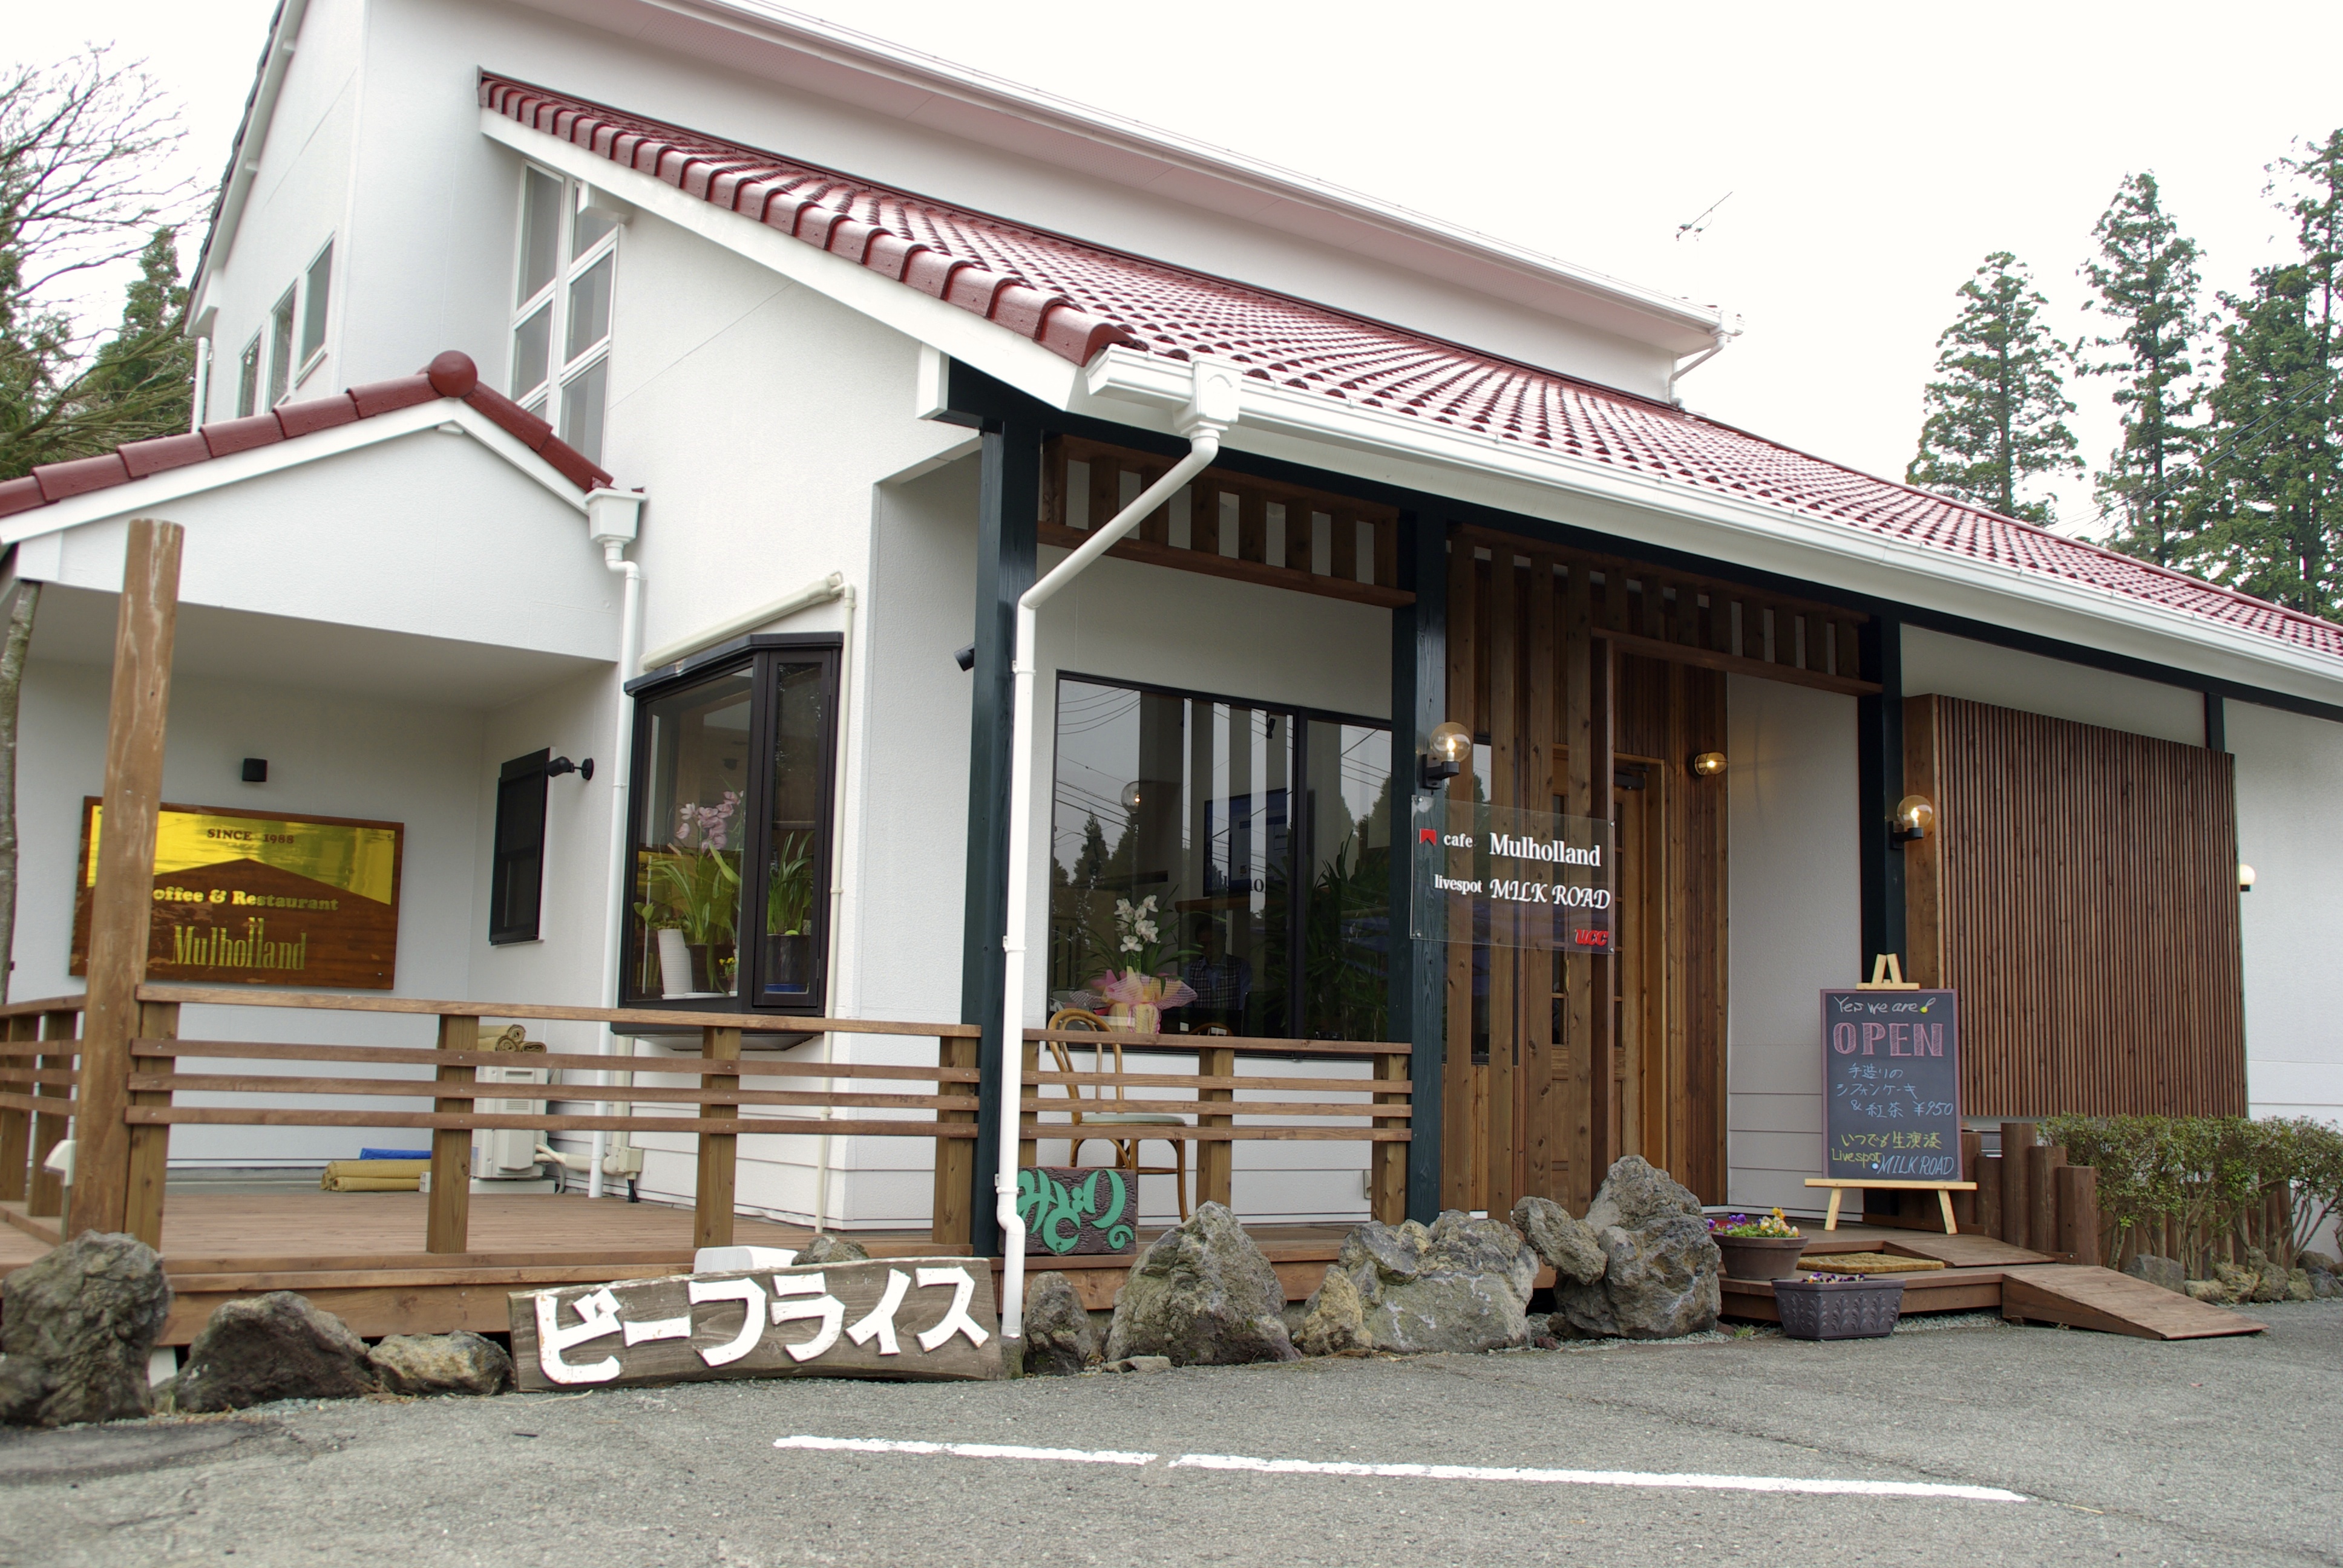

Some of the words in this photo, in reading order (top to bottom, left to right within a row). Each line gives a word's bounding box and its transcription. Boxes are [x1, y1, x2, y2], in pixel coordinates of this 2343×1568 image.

[207, 828, 252, 841] SINCE
[263, 834, 294, 844] 1988
[1443, 833, 1473, 848] cafe
[1489, 832, 1601, 867] Mulholland
[152, 886, 204, 902] offee
[209, 889, 227, 904] &
[232, 890, 339, 910] Restaurant
[1434, 874, 1483, 895] livespot
[1490, 879, 1548, 903] MILK
[1552, 884, 1611, 909] ROAD
[171, 917, 306, 970] Mulholland
[1833, 996, 1864, 1013] Yes
[1867, 1002, 1888, 1015] we
[1833, 1022, 1944, 1057] OPEN
[1848, 1062, 1903, 1079] 手造りの
[1837, 1083, 1918, 1100] シフォンケーキ
[1850, 1099, 1863, 1111] &
[1865, 1102, 1904, 1118] 紅茶
[1876, 1154, 1919, 1175] MILK
[1919, 1155, 1955, 1175] ROAD
[534, 1266, 990, 1385] ビーフライス
